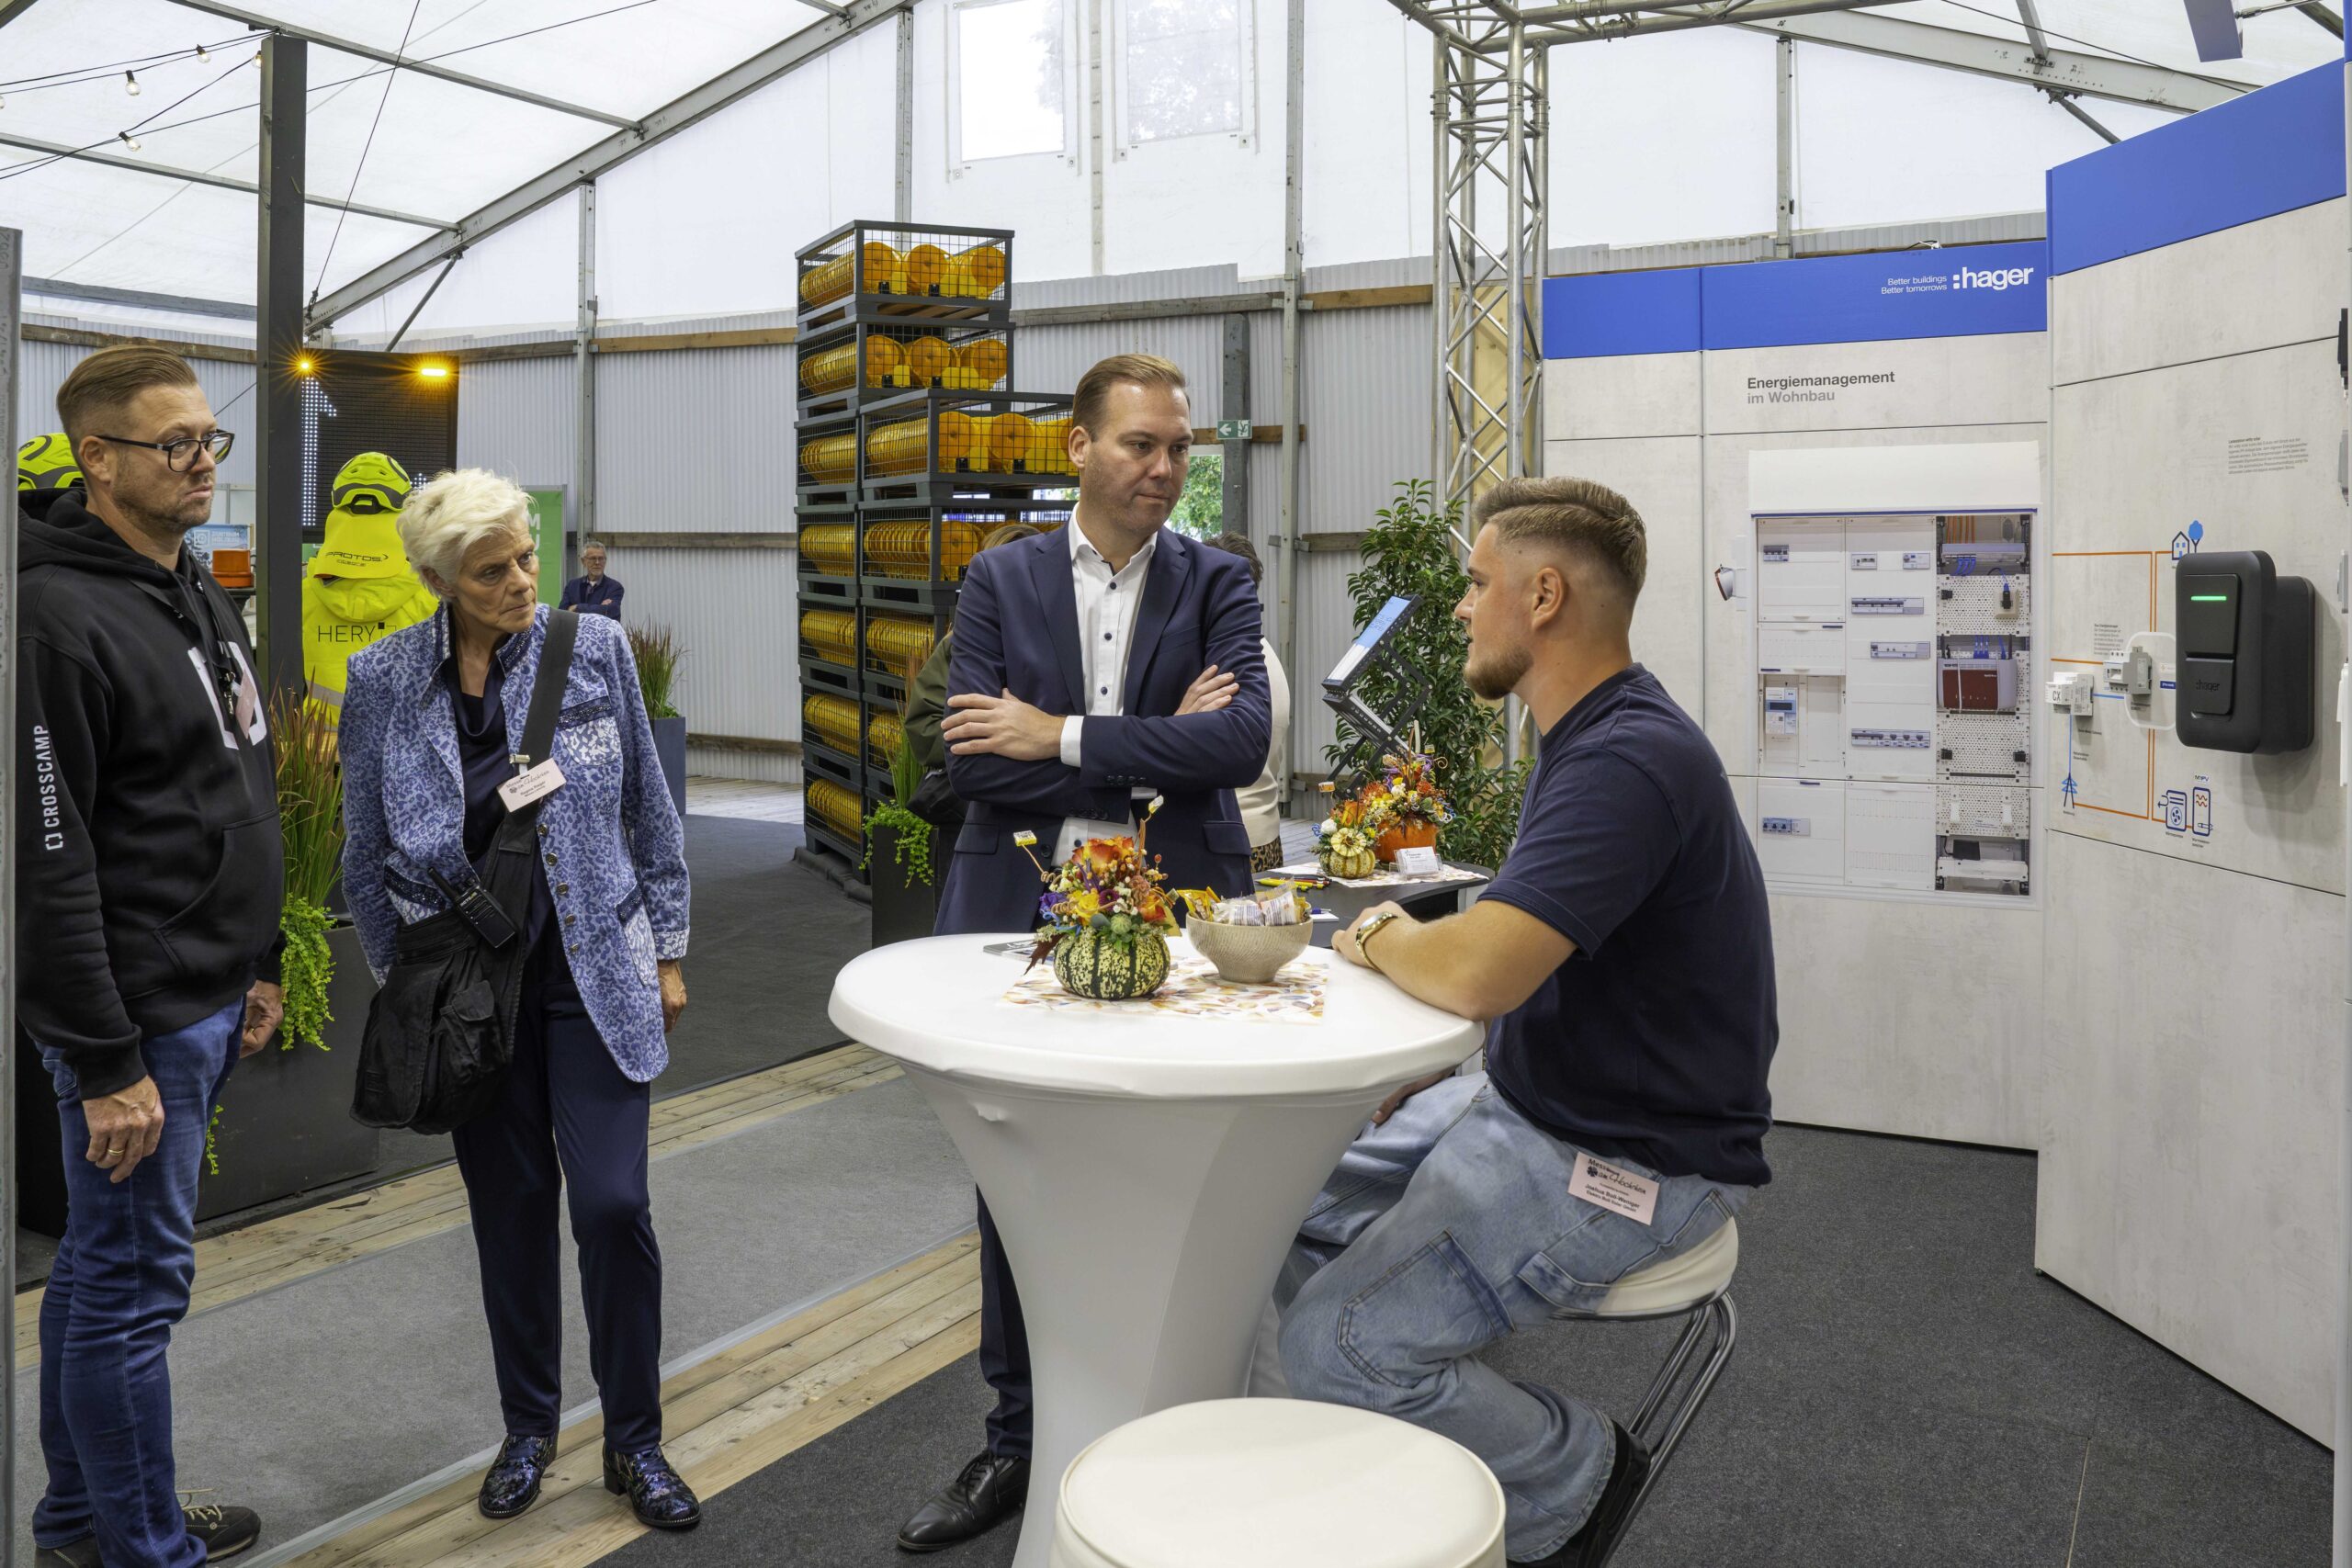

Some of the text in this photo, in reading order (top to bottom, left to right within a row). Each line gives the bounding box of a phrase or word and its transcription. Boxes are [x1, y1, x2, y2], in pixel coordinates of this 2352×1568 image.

[1887, 275, 1948, 287] Better buildings
[1881, 284, 1948, 295] Better tomorrows
[1747, 371, 1895, 390] Energiemanagement
[1747, 389, 1836, 405] im Wohnbau
[2052, 690, 2061, 702] CX
[33, 725, 60, 829] CROSSCAMP
